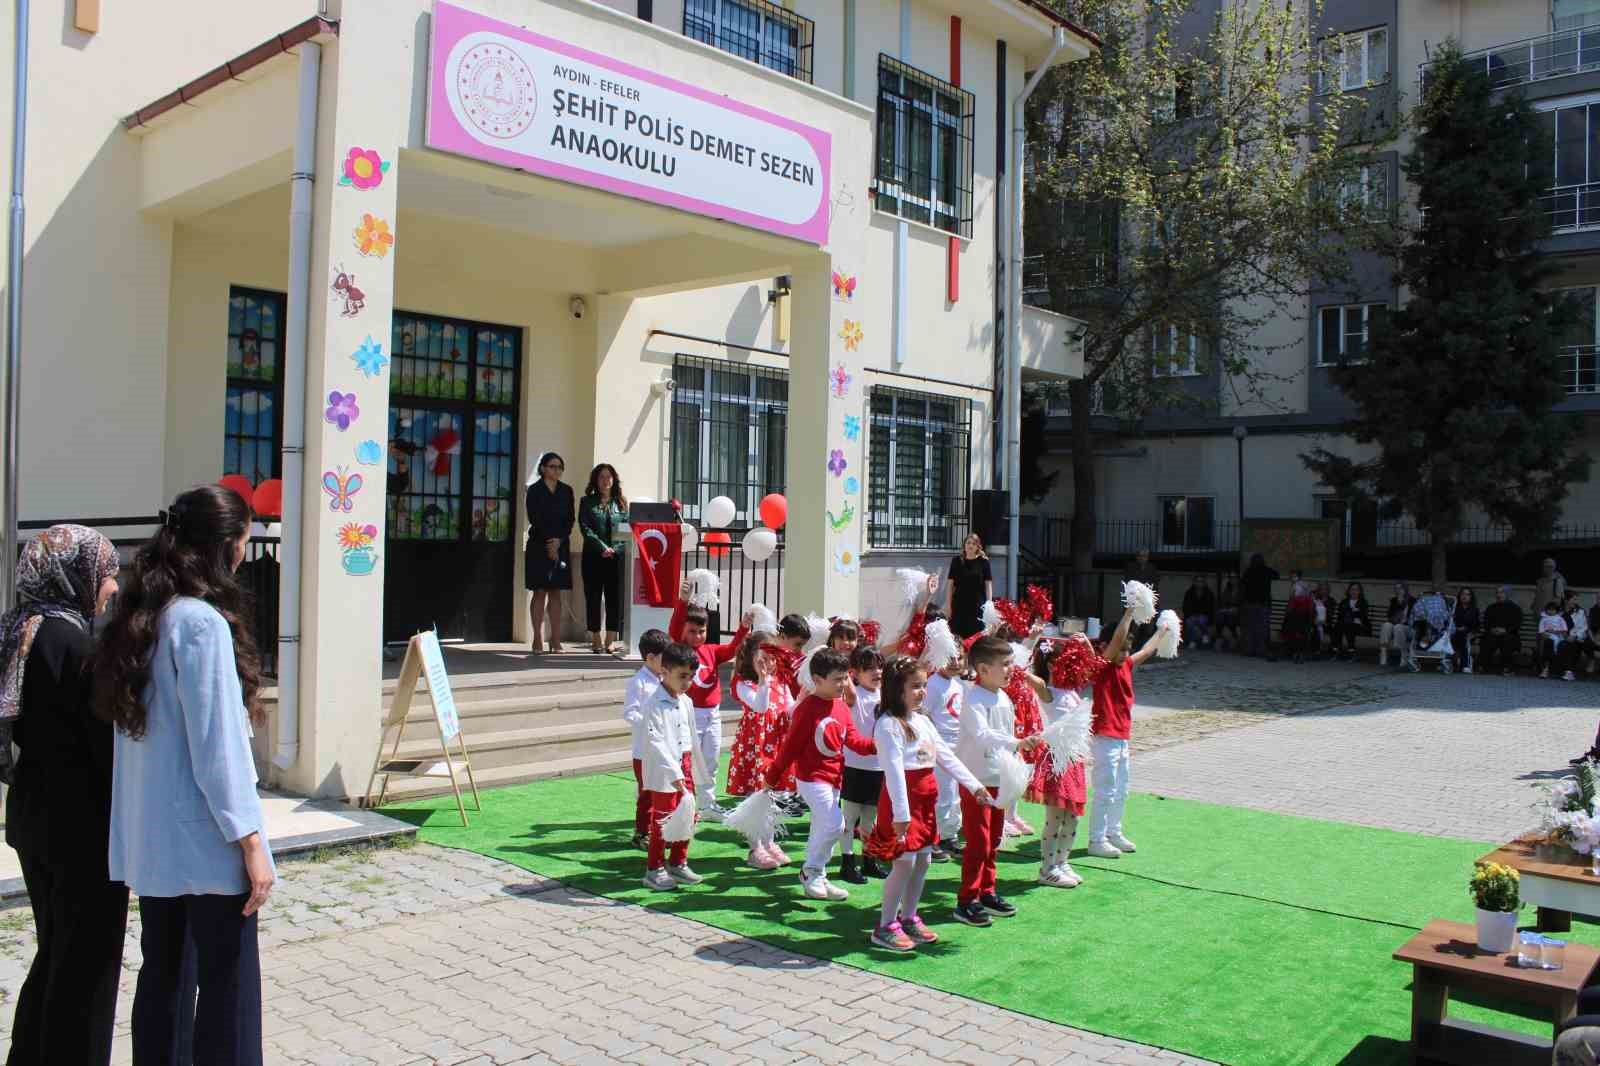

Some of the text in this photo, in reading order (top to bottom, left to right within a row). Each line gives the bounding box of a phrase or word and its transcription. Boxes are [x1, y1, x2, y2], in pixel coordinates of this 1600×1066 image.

[553, 64, 590, 86] AYDIN
[599, 79, 641, 102] EFELER
[550, 124, 677, 177] ANAOKULU
[553, 88, 618, 126] ŞEHİT
[624, 108, 684, 146] POLİS
[690, 129, 755, 167] DEMET
[760, 151, 815, 186] SEZEN
